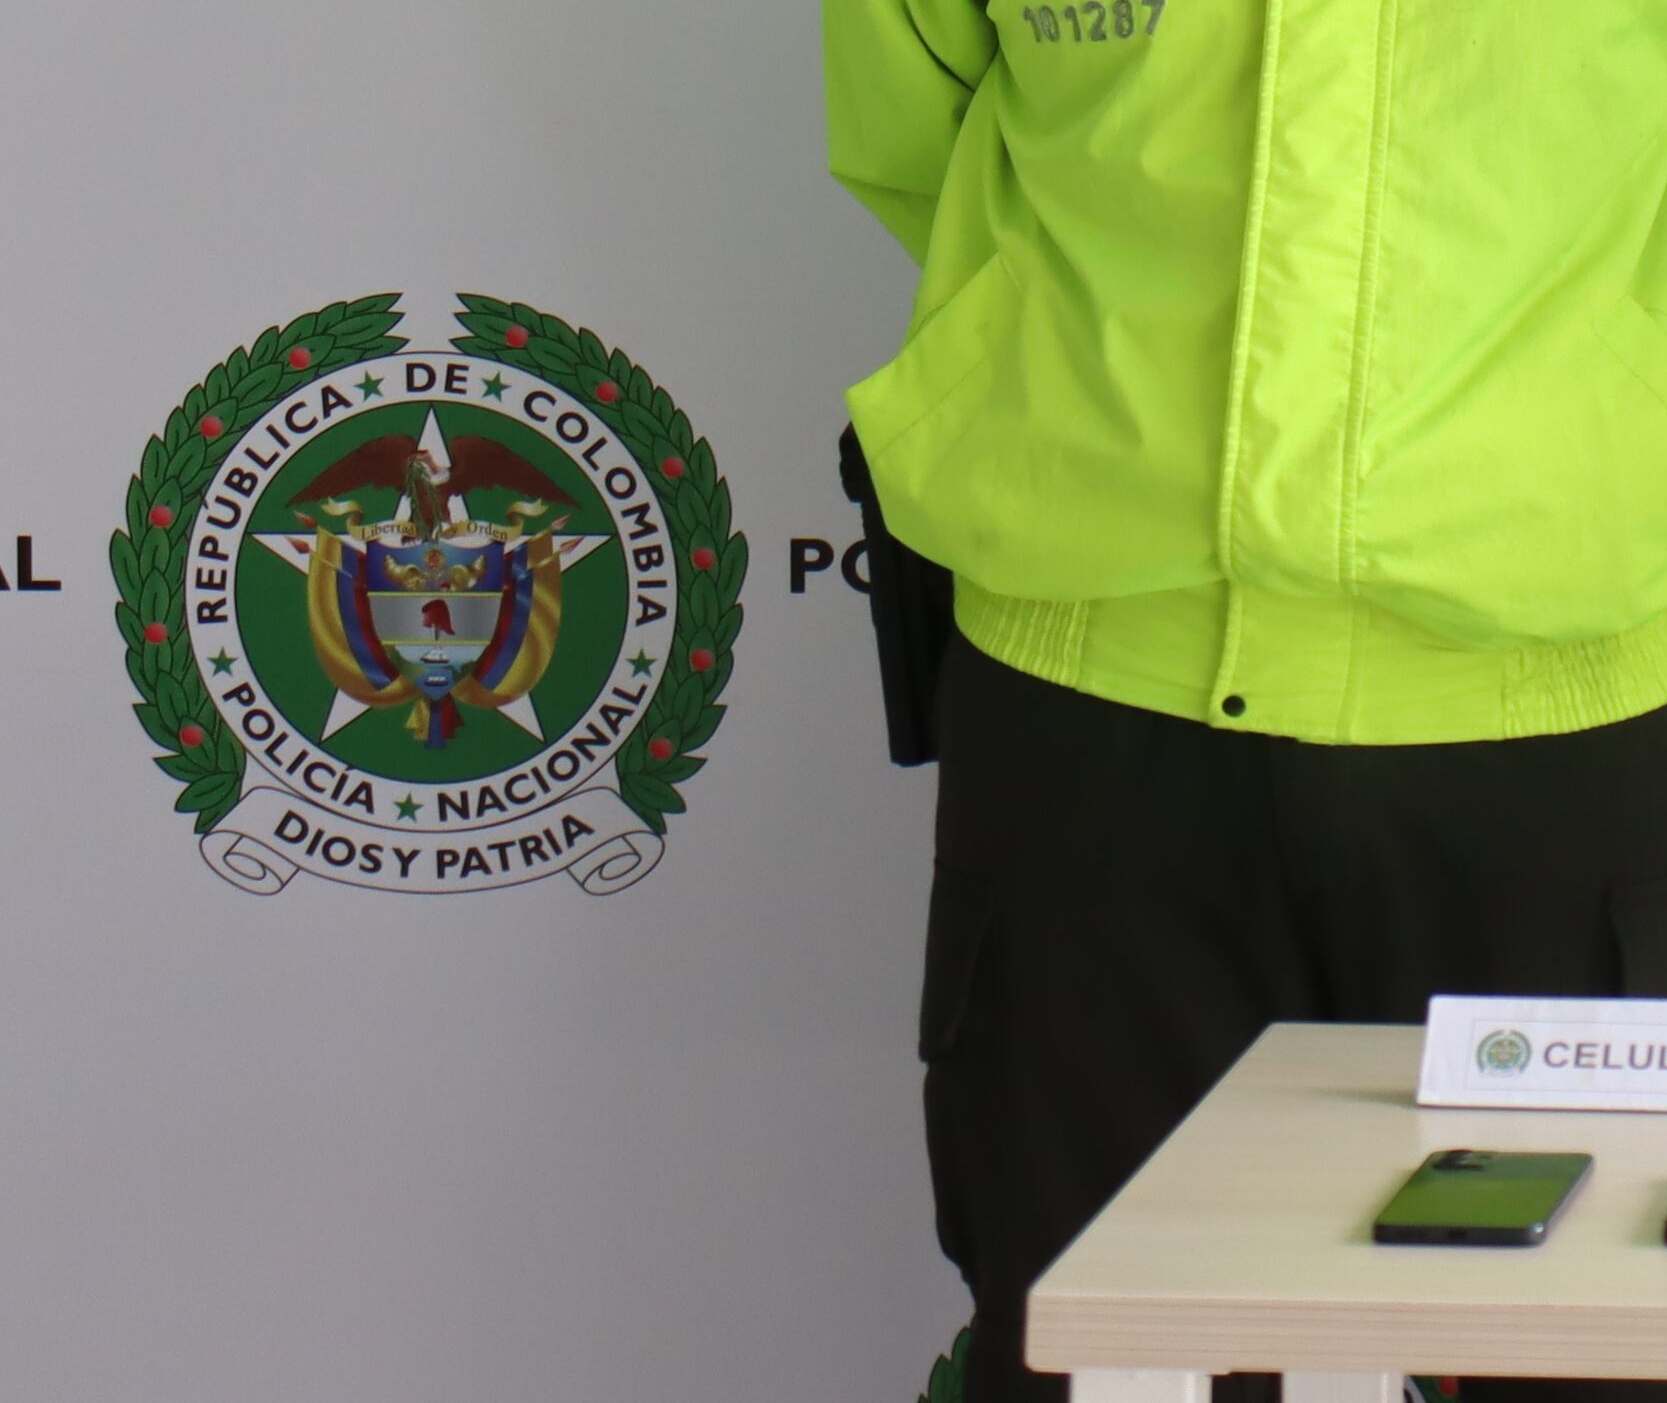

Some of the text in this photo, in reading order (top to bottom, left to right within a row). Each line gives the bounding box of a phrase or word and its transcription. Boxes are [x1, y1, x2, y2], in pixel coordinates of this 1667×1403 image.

[196, 362, 669, 627] REPÚBLICA DE COLOMBIA
[222, 679, 648, 823] POLICÍA NACIONAL
[436, 814, 595, 879] PATRIA
